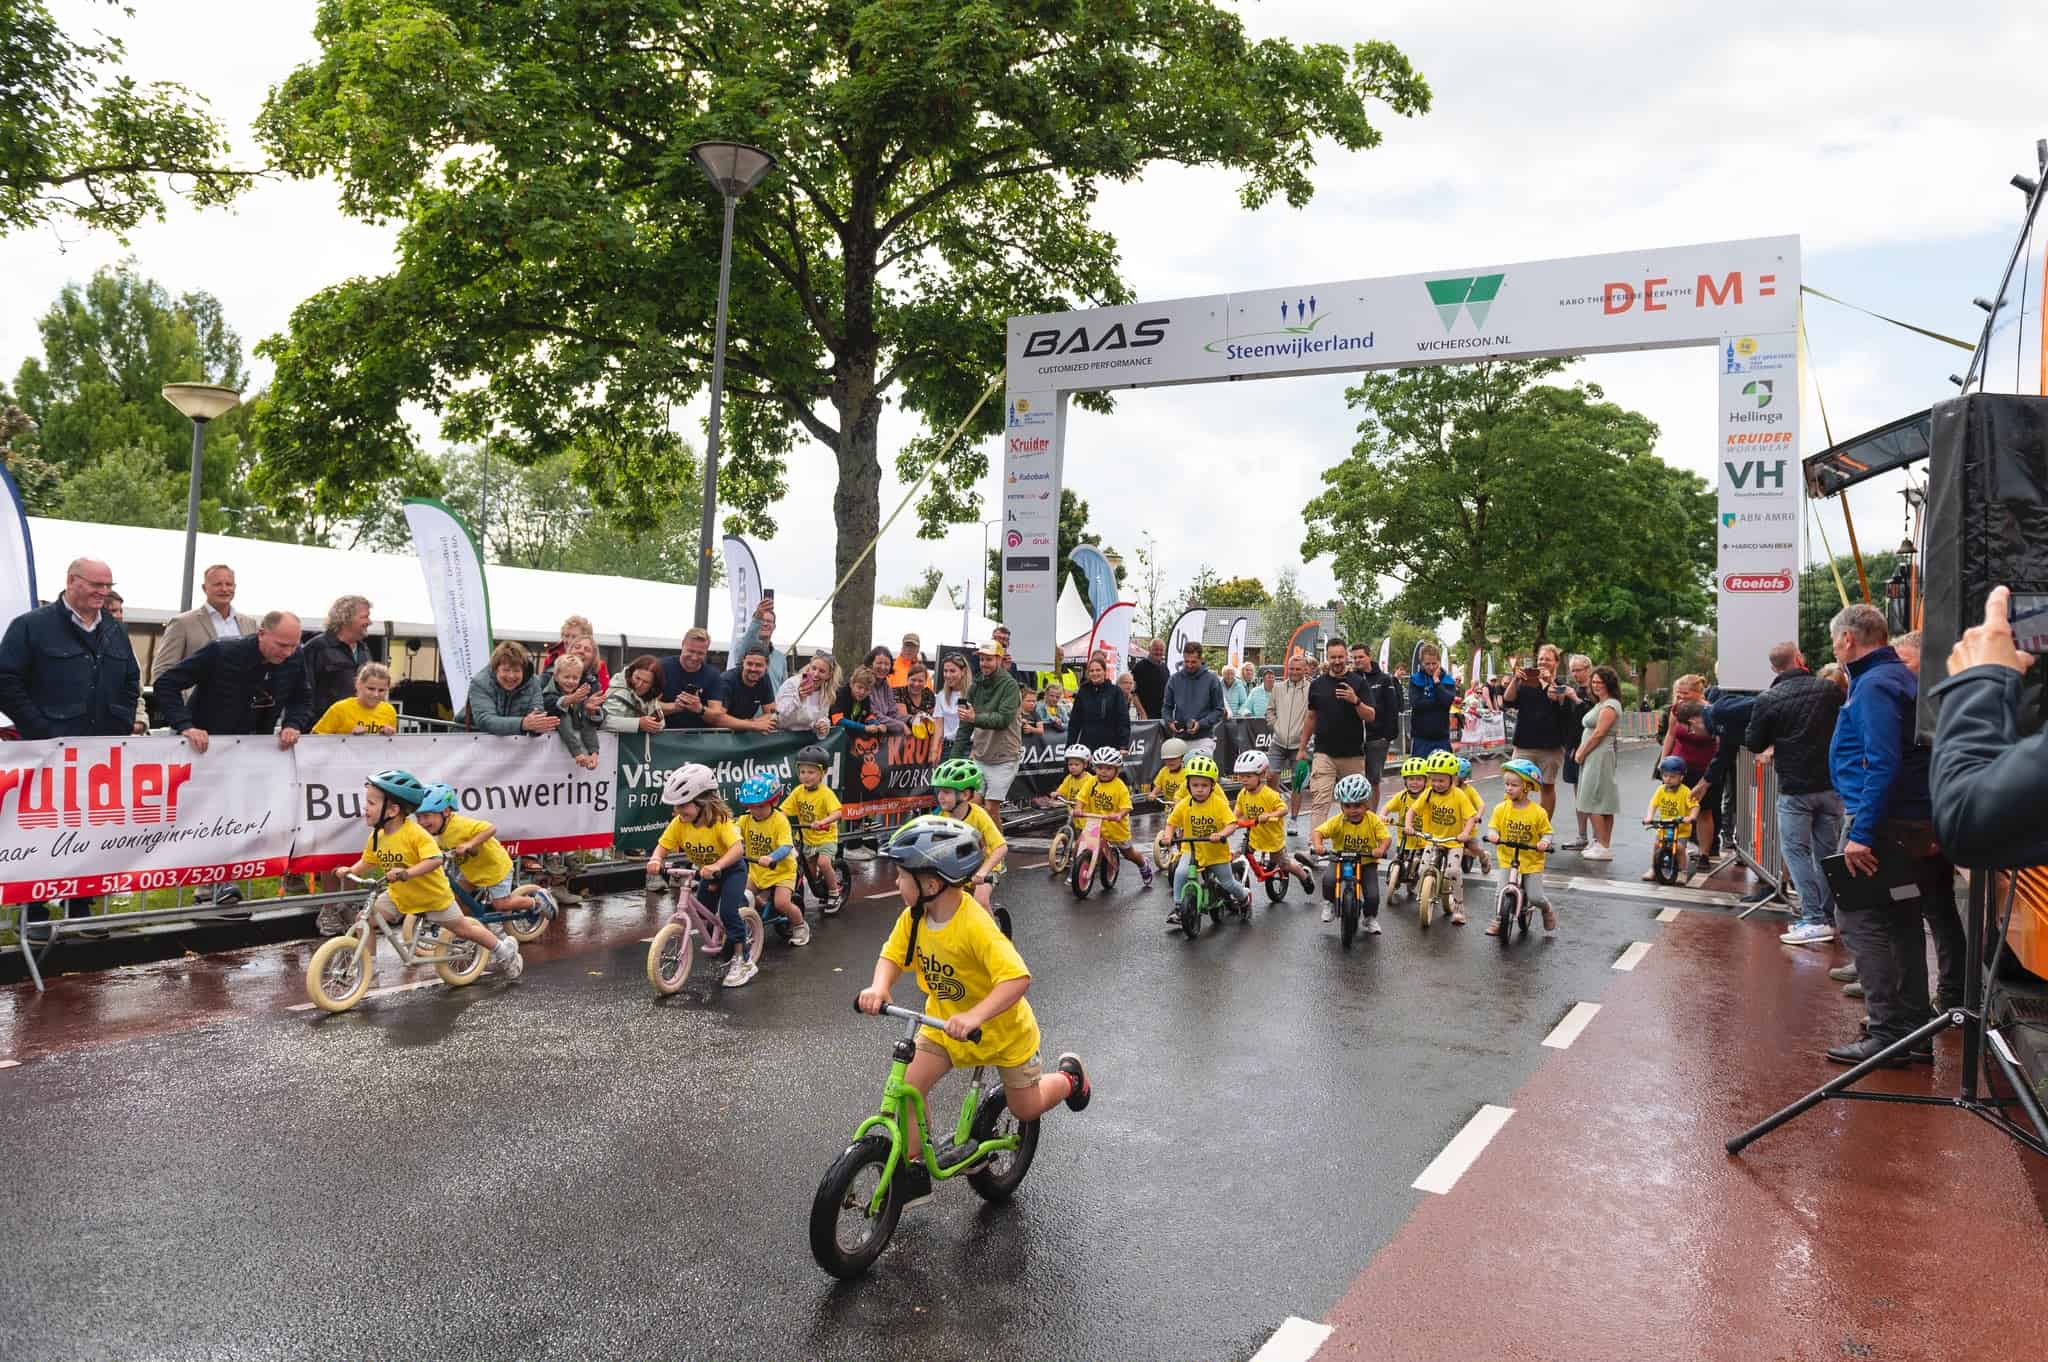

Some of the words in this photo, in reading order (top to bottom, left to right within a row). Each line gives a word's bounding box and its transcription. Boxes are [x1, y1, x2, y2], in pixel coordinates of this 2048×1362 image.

[1604, 278, 1668, 315] DE
[1022, 318, 1171, 358] BAAS
[1226, 331, 1375, 360] Steenwijkerland
[1416, 335, 1512, 352] WICHERSON.NL
[1038, 362, 1090, 374] CUSTOMIZED
[1091, 357, 1153, 371] PERFORMANCE
[1729, 411, 1783, 424] Hellinga
[1010, 437, 1050, 453] Kruider
[1727, 432, 1792, 445] KRUIDER
[1724, 460, 1784, 489] VH
[1765, 512, 1795, 521] AMRO
[1731, 578, 1785, 590] Roelofs
[51, 832, 90, 857] Uw
[101, 810, 272, 853] woninginrichter!
[31, 880, 79, 899] 0521
[101, 873, 133, 893] 512
[231, 862, 266, 880] 995
